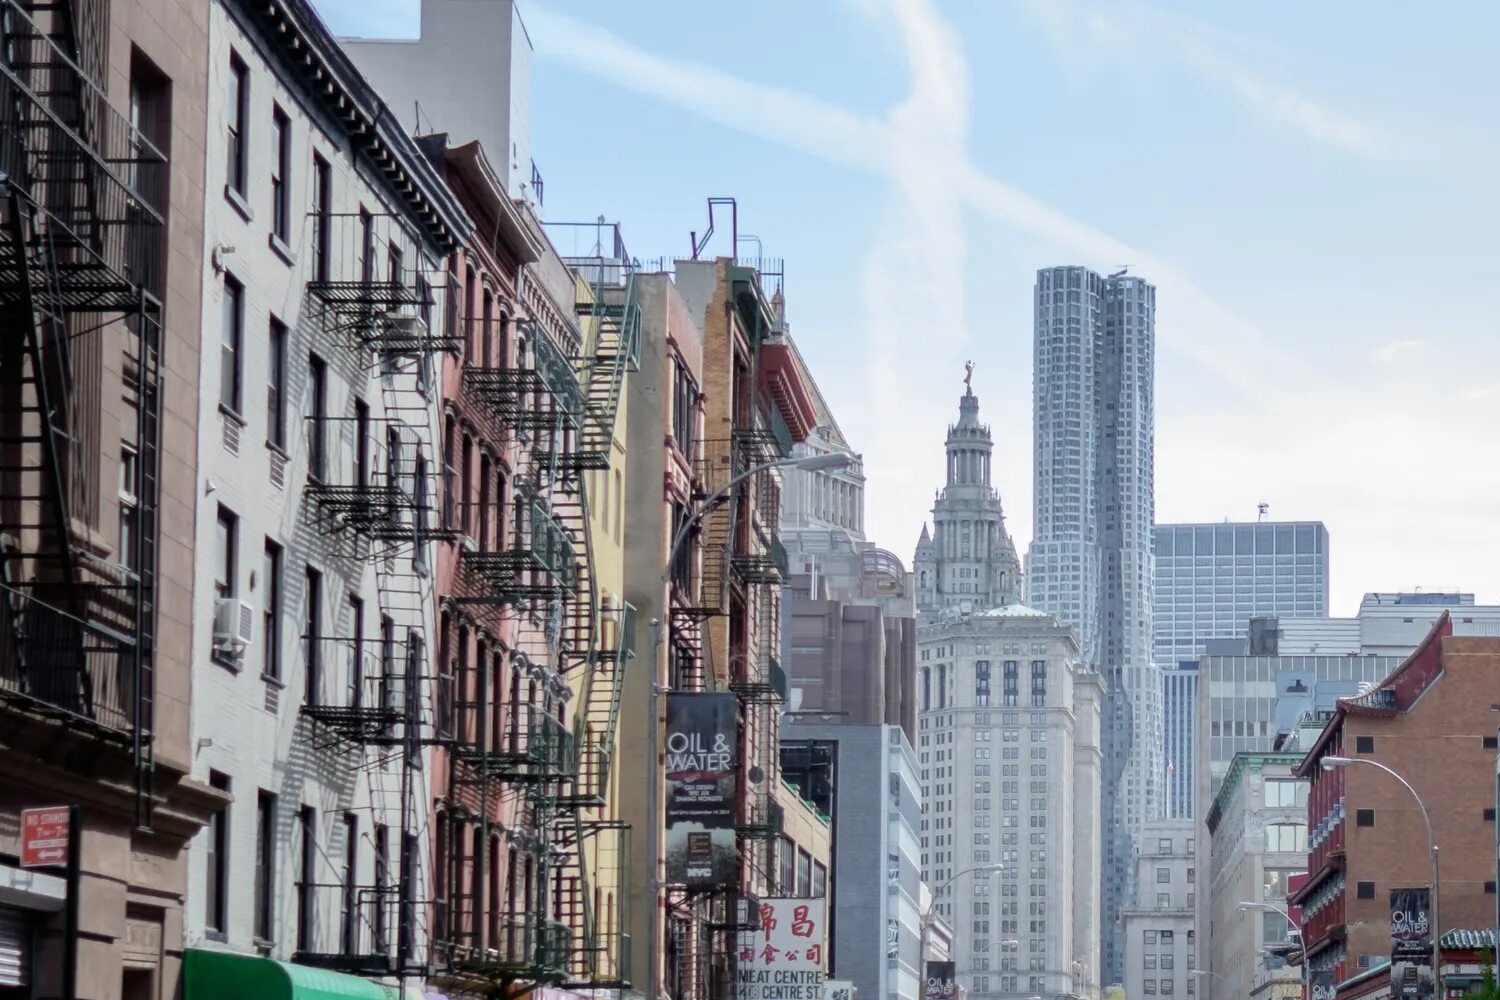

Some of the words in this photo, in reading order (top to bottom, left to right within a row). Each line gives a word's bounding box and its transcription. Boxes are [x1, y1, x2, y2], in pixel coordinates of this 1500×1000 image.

[668, 732, 708, 753] OIL
[713, 733, 730, 753] &
[667, 753, 731, 770] WATER
[1392, 911, 1414, 923] OIL
[1418, 911, 1428, 923] &
[1392, 922, 1428, 933] WATER
[740, 943, 822, 966] 肉食公司
[739, 970, 771, 984] MEAT
[775, 970, 824, 985] CENTRE
[927, 977, 943, 987] OIL
[946, 978, 954, 987] &
[762, 985, 803, 1000] CENTRE
[806, 985, 821, 999] ST.
[927, 986, 954, 995] WATER
